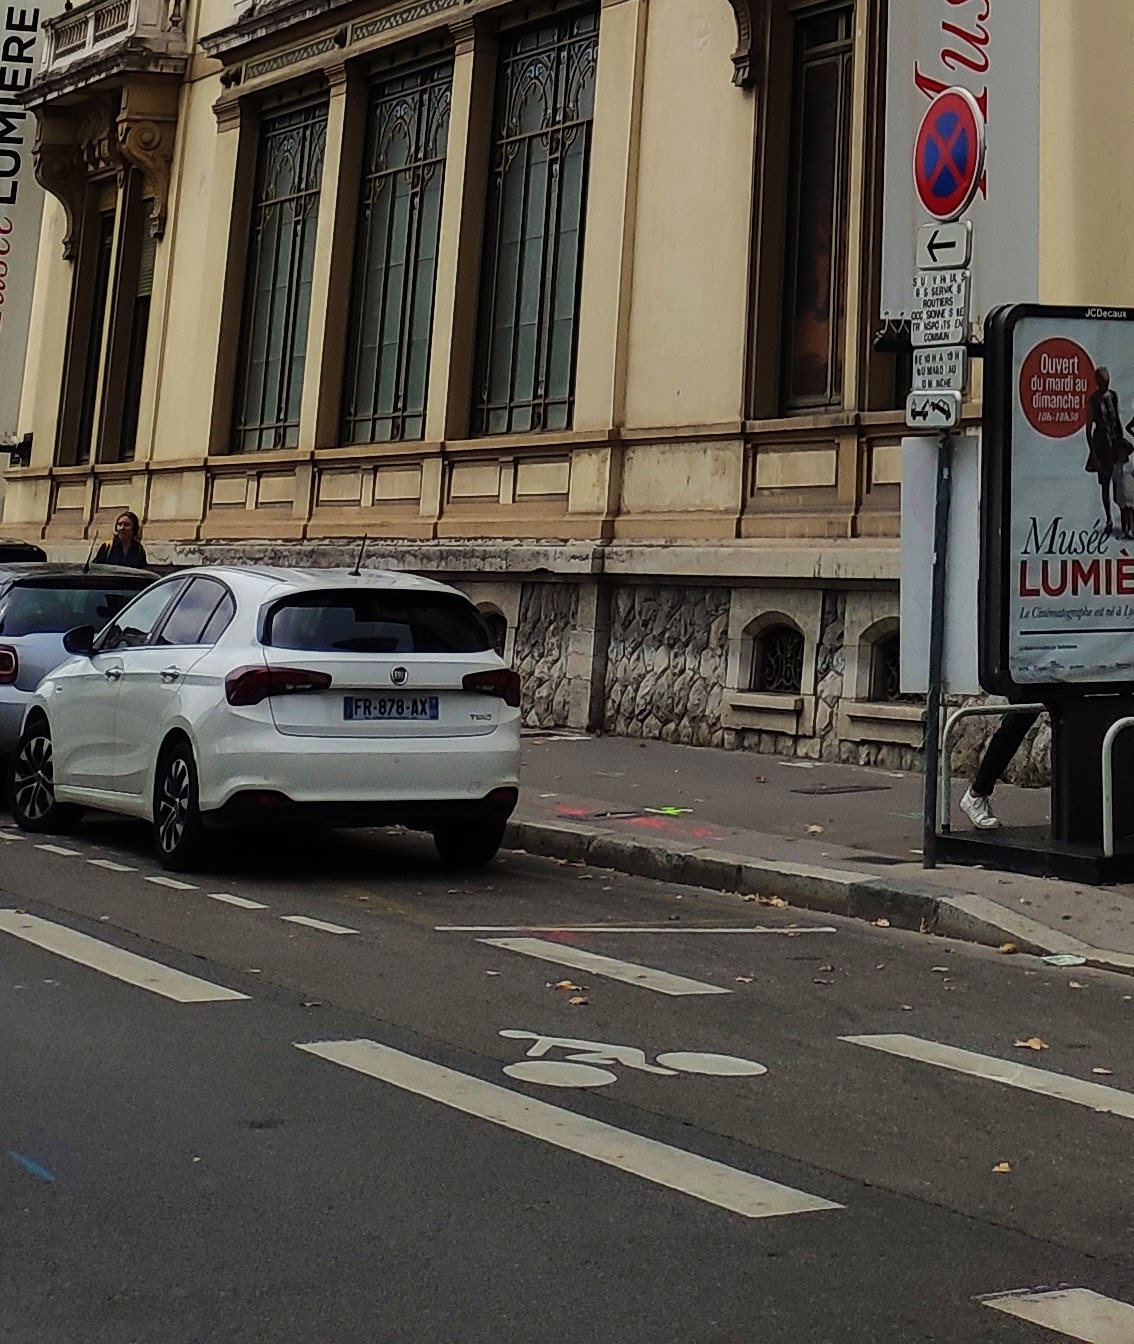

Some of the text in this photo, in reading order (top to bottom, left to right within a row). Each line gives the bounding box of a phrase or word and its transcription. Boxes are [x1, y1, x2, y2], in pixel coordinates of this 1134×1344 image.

[1084, 308, 1127, 318] JCDecaux
[1040, 353, 1079, 375] Ouvert
[1030, 374, 1088, 392] du mardi au
[1032, 393, 1080, 409] dimanche
[1020, 516, 1112, 555] Musée
[354, 698, 429, 717] FR-878-AX
